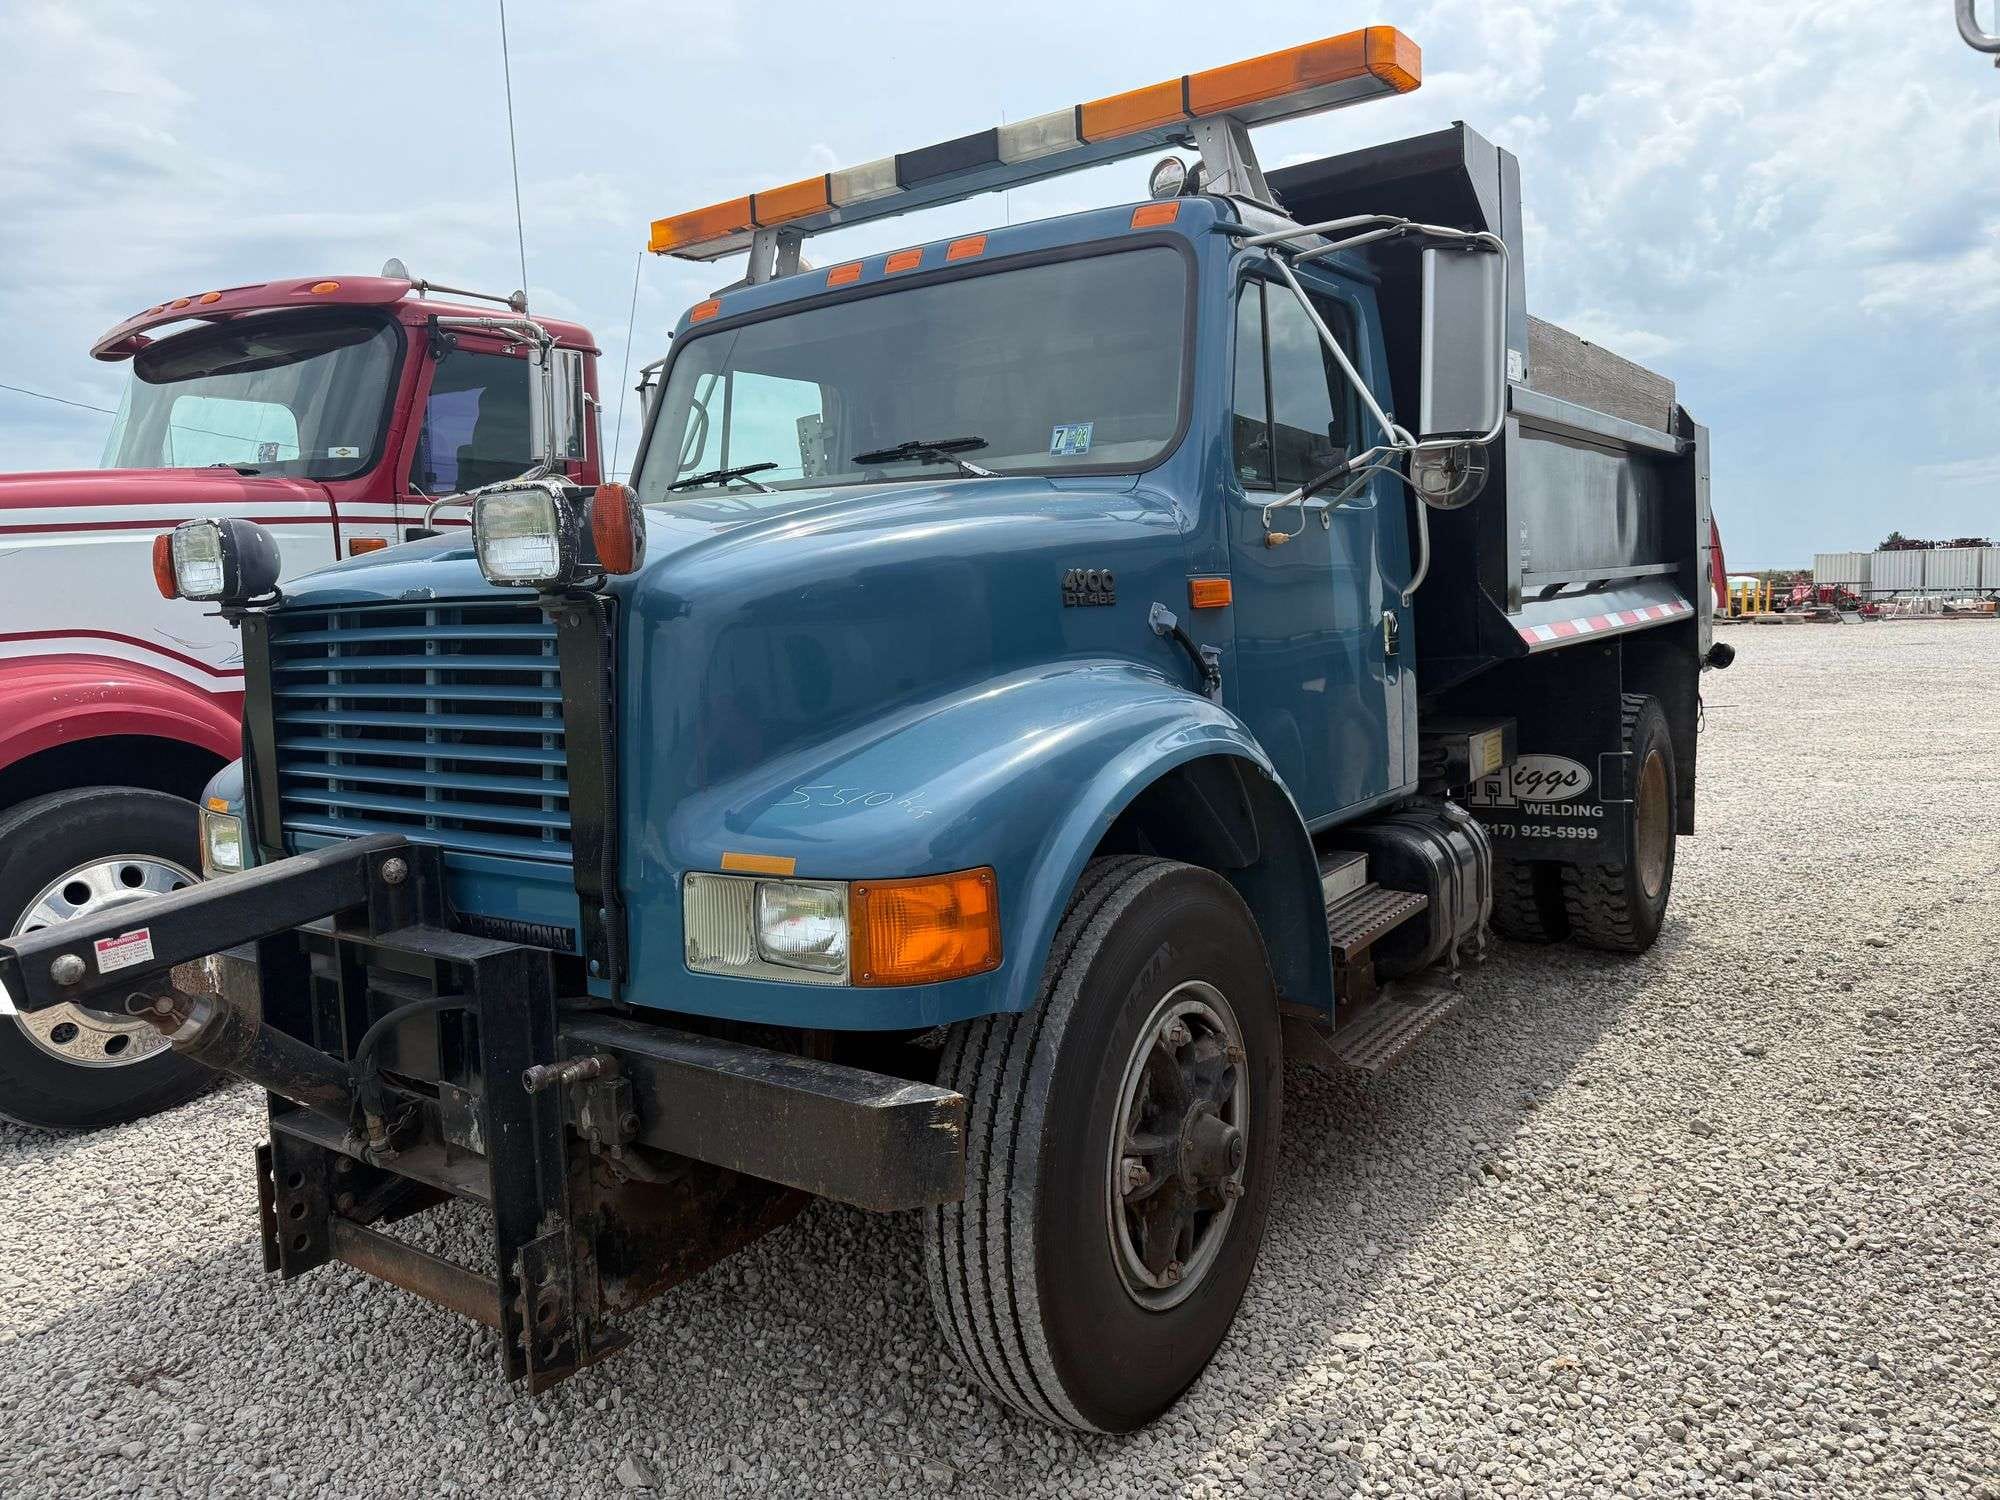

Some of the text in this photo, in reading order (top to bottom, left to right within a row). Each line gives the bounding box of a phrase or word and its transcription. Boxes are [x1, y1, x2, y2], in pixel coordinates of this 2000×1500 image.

[1055, 429, 1065, 448] 7
[1524, 803, 1604, 818] WELDING
[1520, 825, 1598, 840] 925-5999
